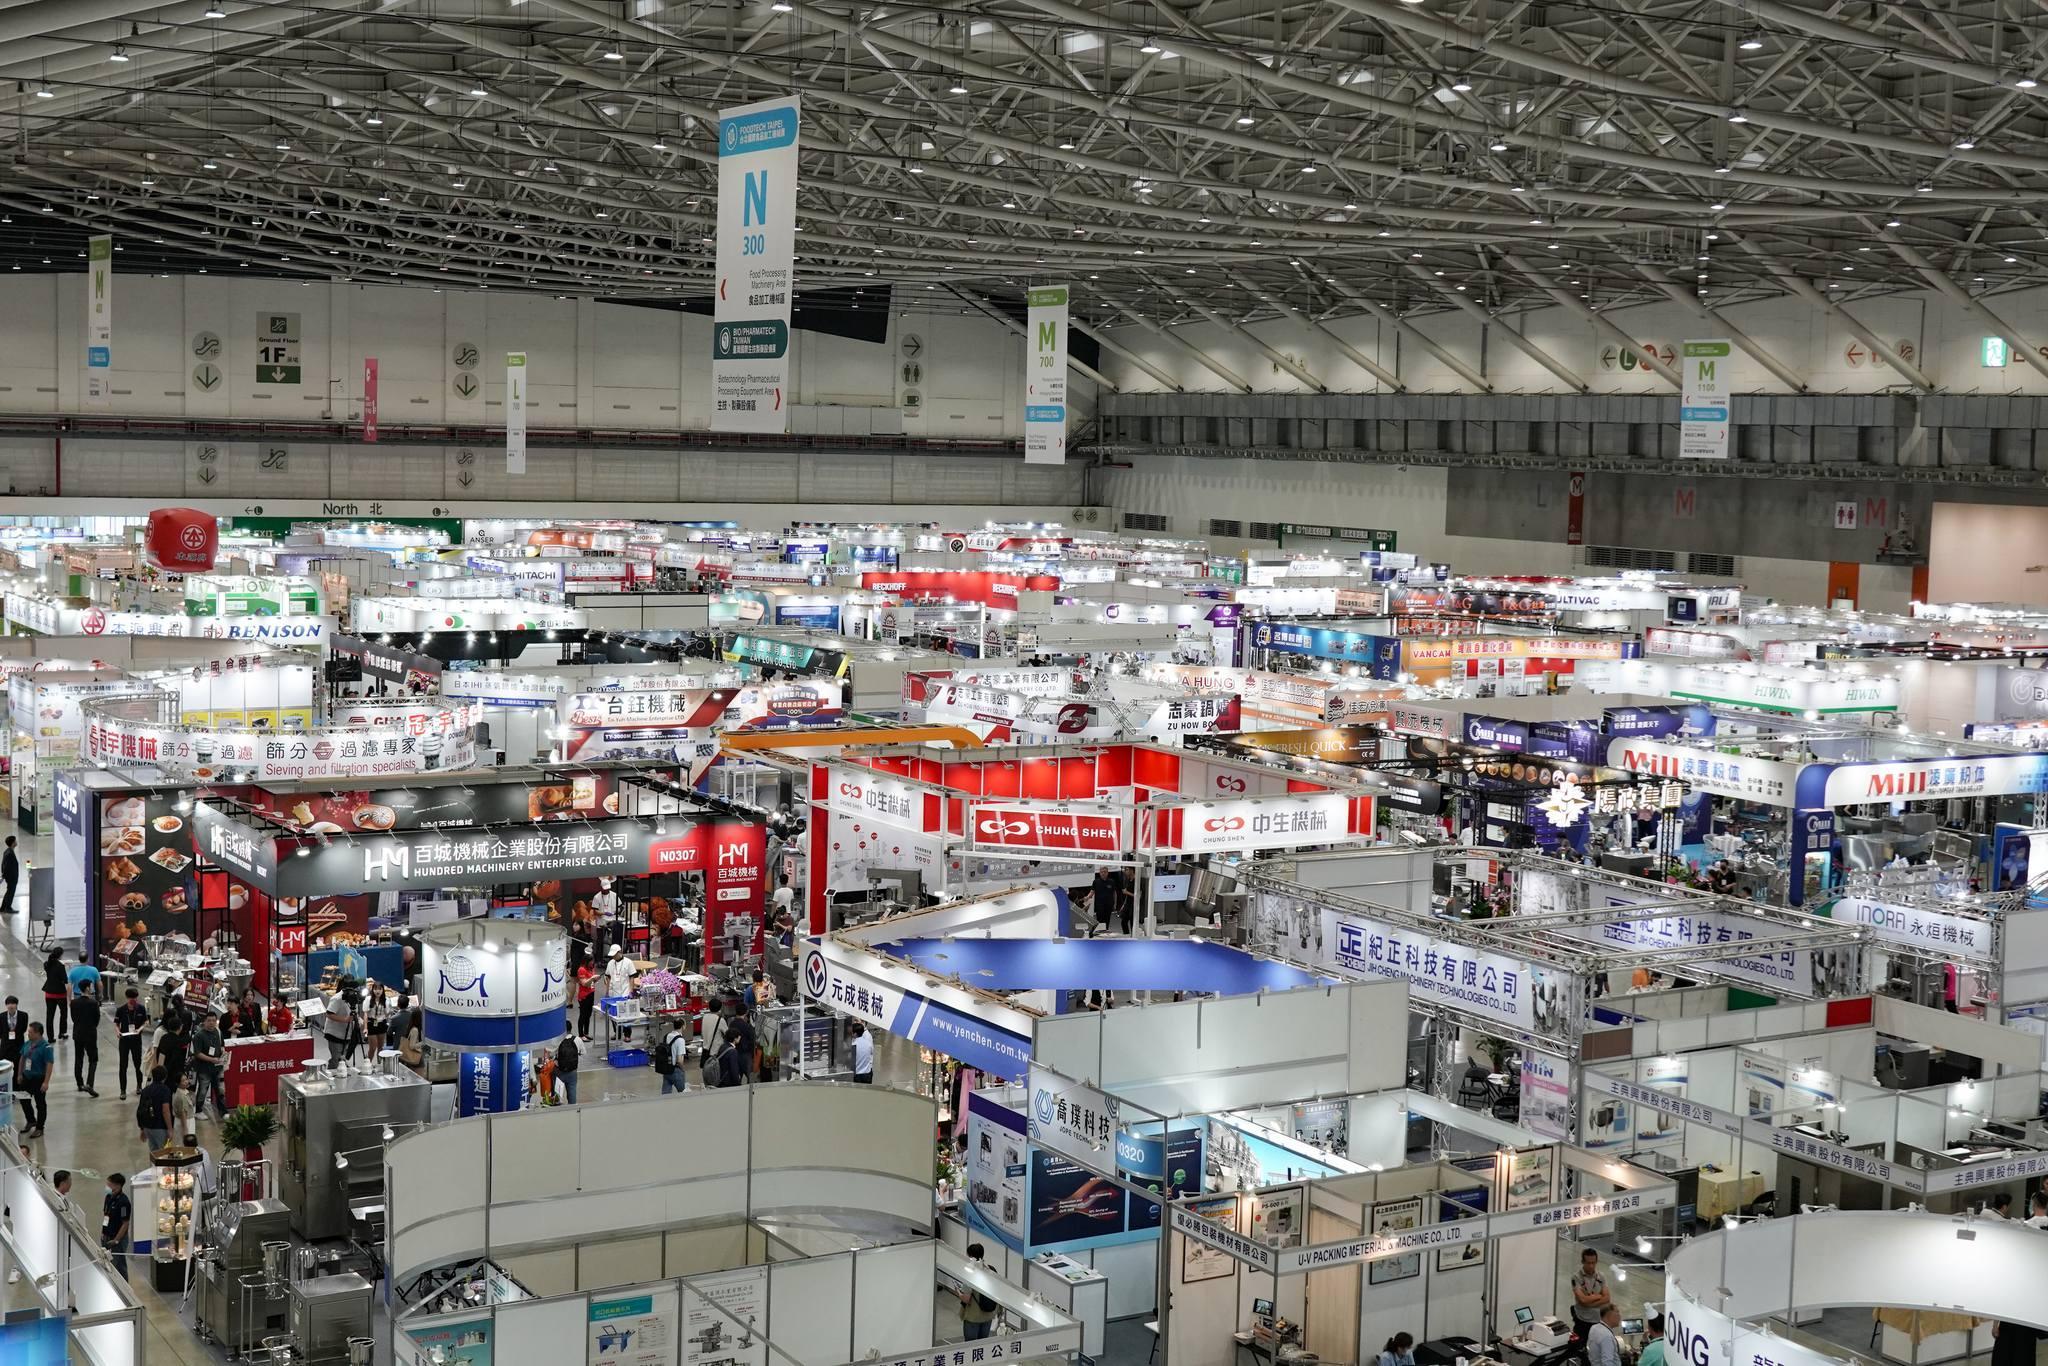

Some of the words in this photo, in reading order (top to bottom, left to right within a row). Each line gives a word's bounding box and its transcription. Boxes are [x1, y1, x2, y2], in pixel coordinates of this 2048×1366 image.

[740, 122, 766, 135] FOODTECH
[767, 119, 784, 130] TAIPEI
[744, 170, 767, 227] N
[743, 234, 764, 256] 300
[750, 270, 760, 279] Food
[762, 268, 786, 279] Processing
[752, 279, 774, 290] Machinery
[1039, 321, 1056, 352] M
[260, 347, 286, 363] 1F
[1040, 357, 1054, 367] 700
[1699, 360, 1715, 381] M
[1698, 384, 1715, 392] 1100
[1573, 479, 1580, 494] M
[323, 503, 358, 516] North
[370, 503, 383, 516] 北
[1677, 488, 1695, 516] M
[1864, 498, 1887, 527] M
[514, 571, 556, 580] HITACHI
[872, 583, 907, 591] BECKHOFF
[1754, 686, 1792, 700] HIWIN
[1845, 688, 1882, 701] HIWIN
[1168, 722, 1178, 731] ZU
[1181, 721, 1200, 730] HOW
[1310, 741, 1346, 752] QUICK
[266, 763, 304, 779] Sieving
[308, 761, 326, 775] and
[372, 755, 416, 772] specialists
[1623, 750, 1679, 778] Mill
[1866, 771, 1927, 797] Mill
[866, 789, 911, 819] 中生機械
[1036, 825, 1079, 836] CHUNG
[1082, 828, 1117, 839] SHEN
[1253, 810, 1328, 834] 中生機械
[364, 846, 409, 881] HM
[414, 833, 629, 864] 百城機械企業股份有限公司
[660, 849, 696, 863] N0307
[719, 842, 749, 866] HM
[414, 865, 465, 878] HUNDRED
[466, 862, 524, 876] MACHINERY
[528, 858, 588, 871] ENTERPRISE
[589, 854, 628, 867] CO.,LTD.
[717, 866, 758, 879] 百城機械
[1857, 903, 1906, 930] INORA
[280, 930, 306, 949] HM
[1368, 933, 1518, 999] 紀正科技有限公司
[832, 978, 884, 1019] 元成機械
[1367, 963, 1377, 974] JIH
[1378, 964, 1400, 979] CHENG
[1437, 981, 1489, 1007] TECHNOLOGIES
[1503, 1001, 1518, 1015] LTD.
[438, 995, 464, 1007] HONG
[466, 998, 490, 1008] DAU
[932, 1016, 1030, 1063] www.yenchen.com.tw
[240, 1059, 258, 1073] HM
[258, 1059, 295, 1072] 百城機械
[474, 1056, 491, 1118] 鴻道工
[1610, 1081, 1713, 1125] 主典興業股份有限公司
[1772, 1133, 1891, 1181] 主典興業股份有限公司
[1177, 1213, 1268, 1265] 優必勝包裝機材有限公司
[1298, 1252, 1312, 1266] U-V
[1313, 1248, 1348, 1264] PACKING
[1349, 1239, 1387, 1258] METERIAL
[1396, 1230, 1430, 1250] MACHINE
[1447, 1226, 1462, 1241] LTD.
